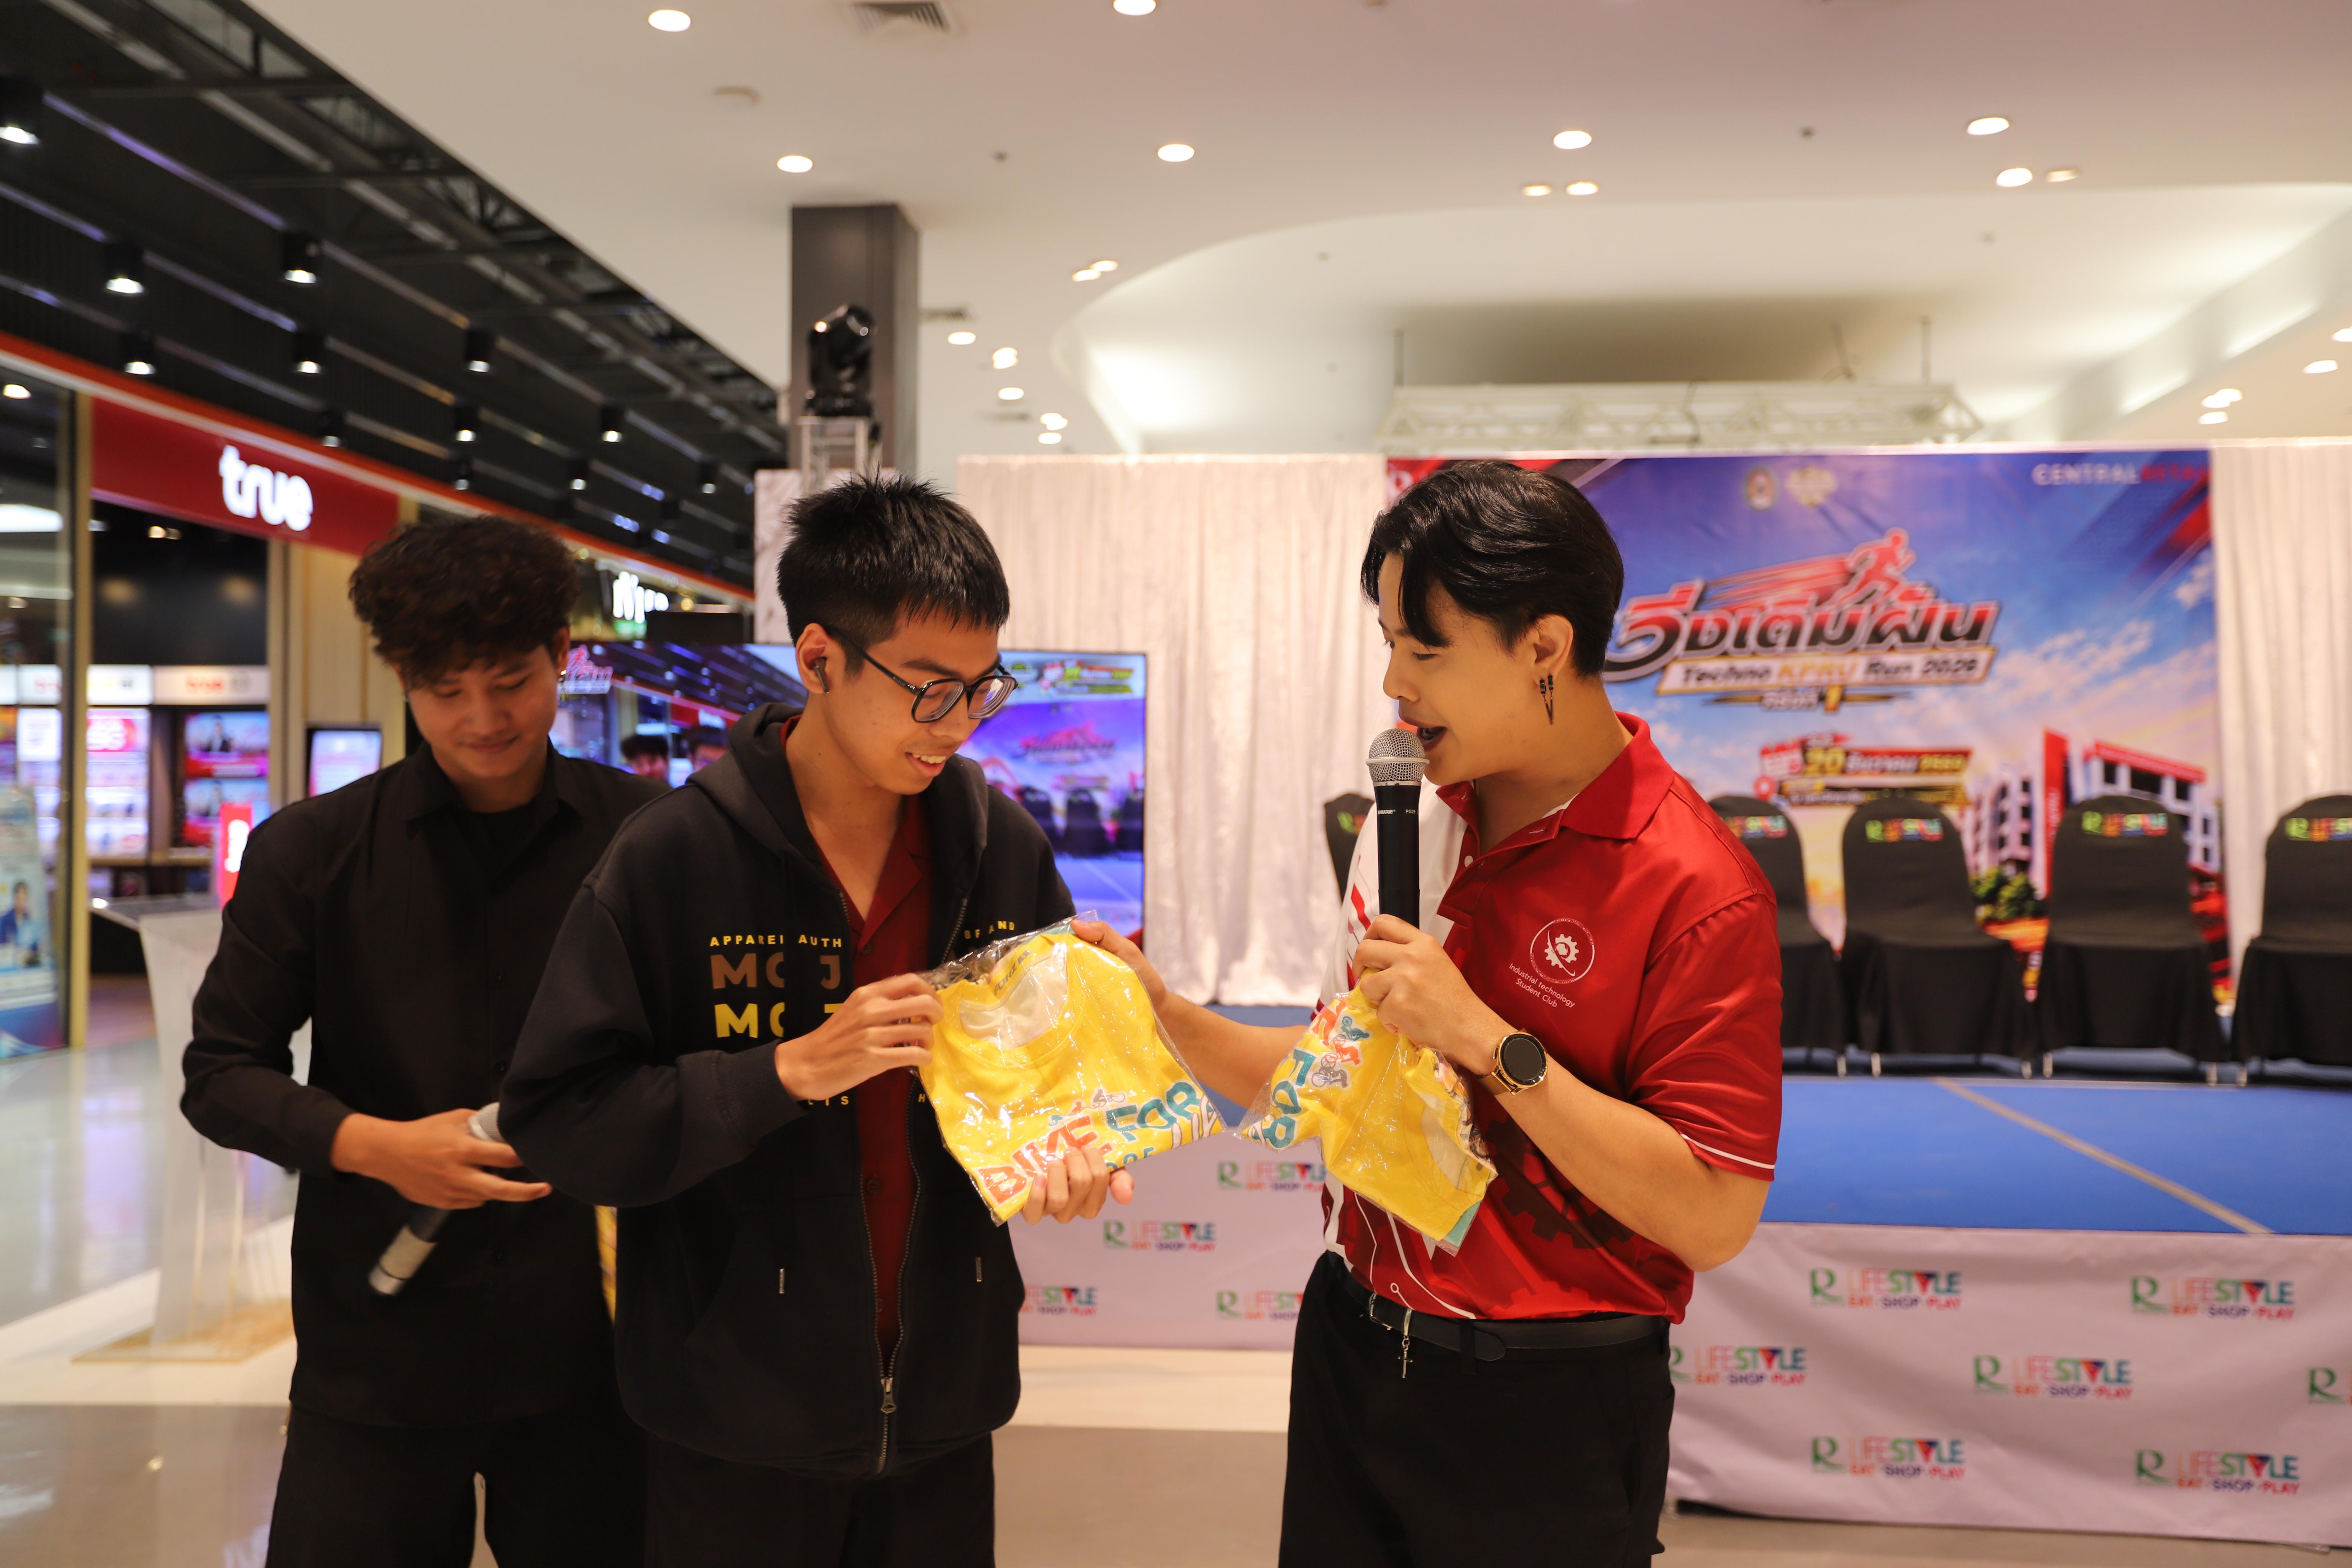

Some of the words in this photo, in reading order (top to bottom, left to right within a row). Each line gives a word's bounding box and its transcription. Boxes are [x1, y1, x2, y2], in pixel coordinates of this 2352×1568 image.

[2032, 463, 2139, 485] CENTRAL
[219, 445, 313, 531] true
[1683, 665, 1772, 683] Techno
[1864, 657, 1913, 678] Run
[1509, 963, 1537, 985] Industrial
[1539, 982, 1576, 1009] technology
[1515, 978, 1540, 998] Student
[1542, 994, 1558, 1008] Club
[1107, 1081, 1203, 1142] FOR
[1304, 1183, 1325, 1192] PLA
[1848, 1269, 1962, 1295] LIFESTYLE
[2173, 1277, 2295, 1305] LIFESTYLE
[1695, 1345, 1807, 1371] LIFESTYLE
[2014, 1357, 2132, 1384] LIFESTYLE
[1849, 1438, 1966, 1464] LIFESTYLE
[2178, 1451, 2299, 1480] LIFESTYLE
